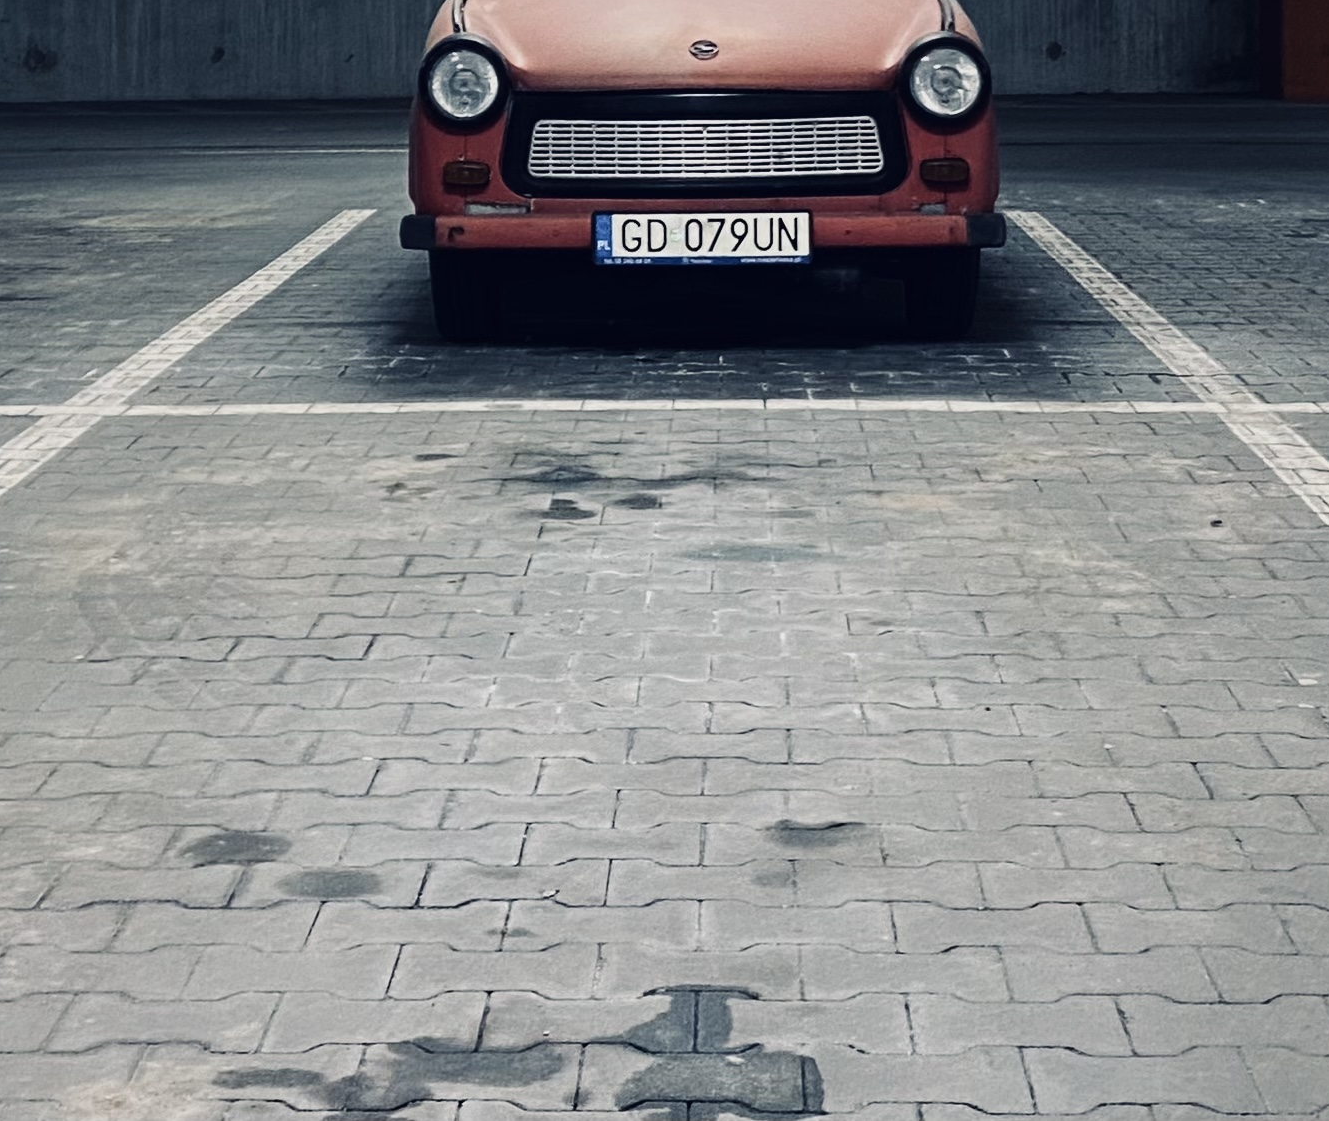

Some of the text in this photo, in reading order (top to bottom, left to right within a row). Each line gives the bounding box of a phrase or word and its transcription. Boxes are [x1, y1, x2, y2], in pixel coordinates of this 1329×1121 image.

[597, 239, 611, 251] PL
[621, 217, 799, 253] GD 079UN
